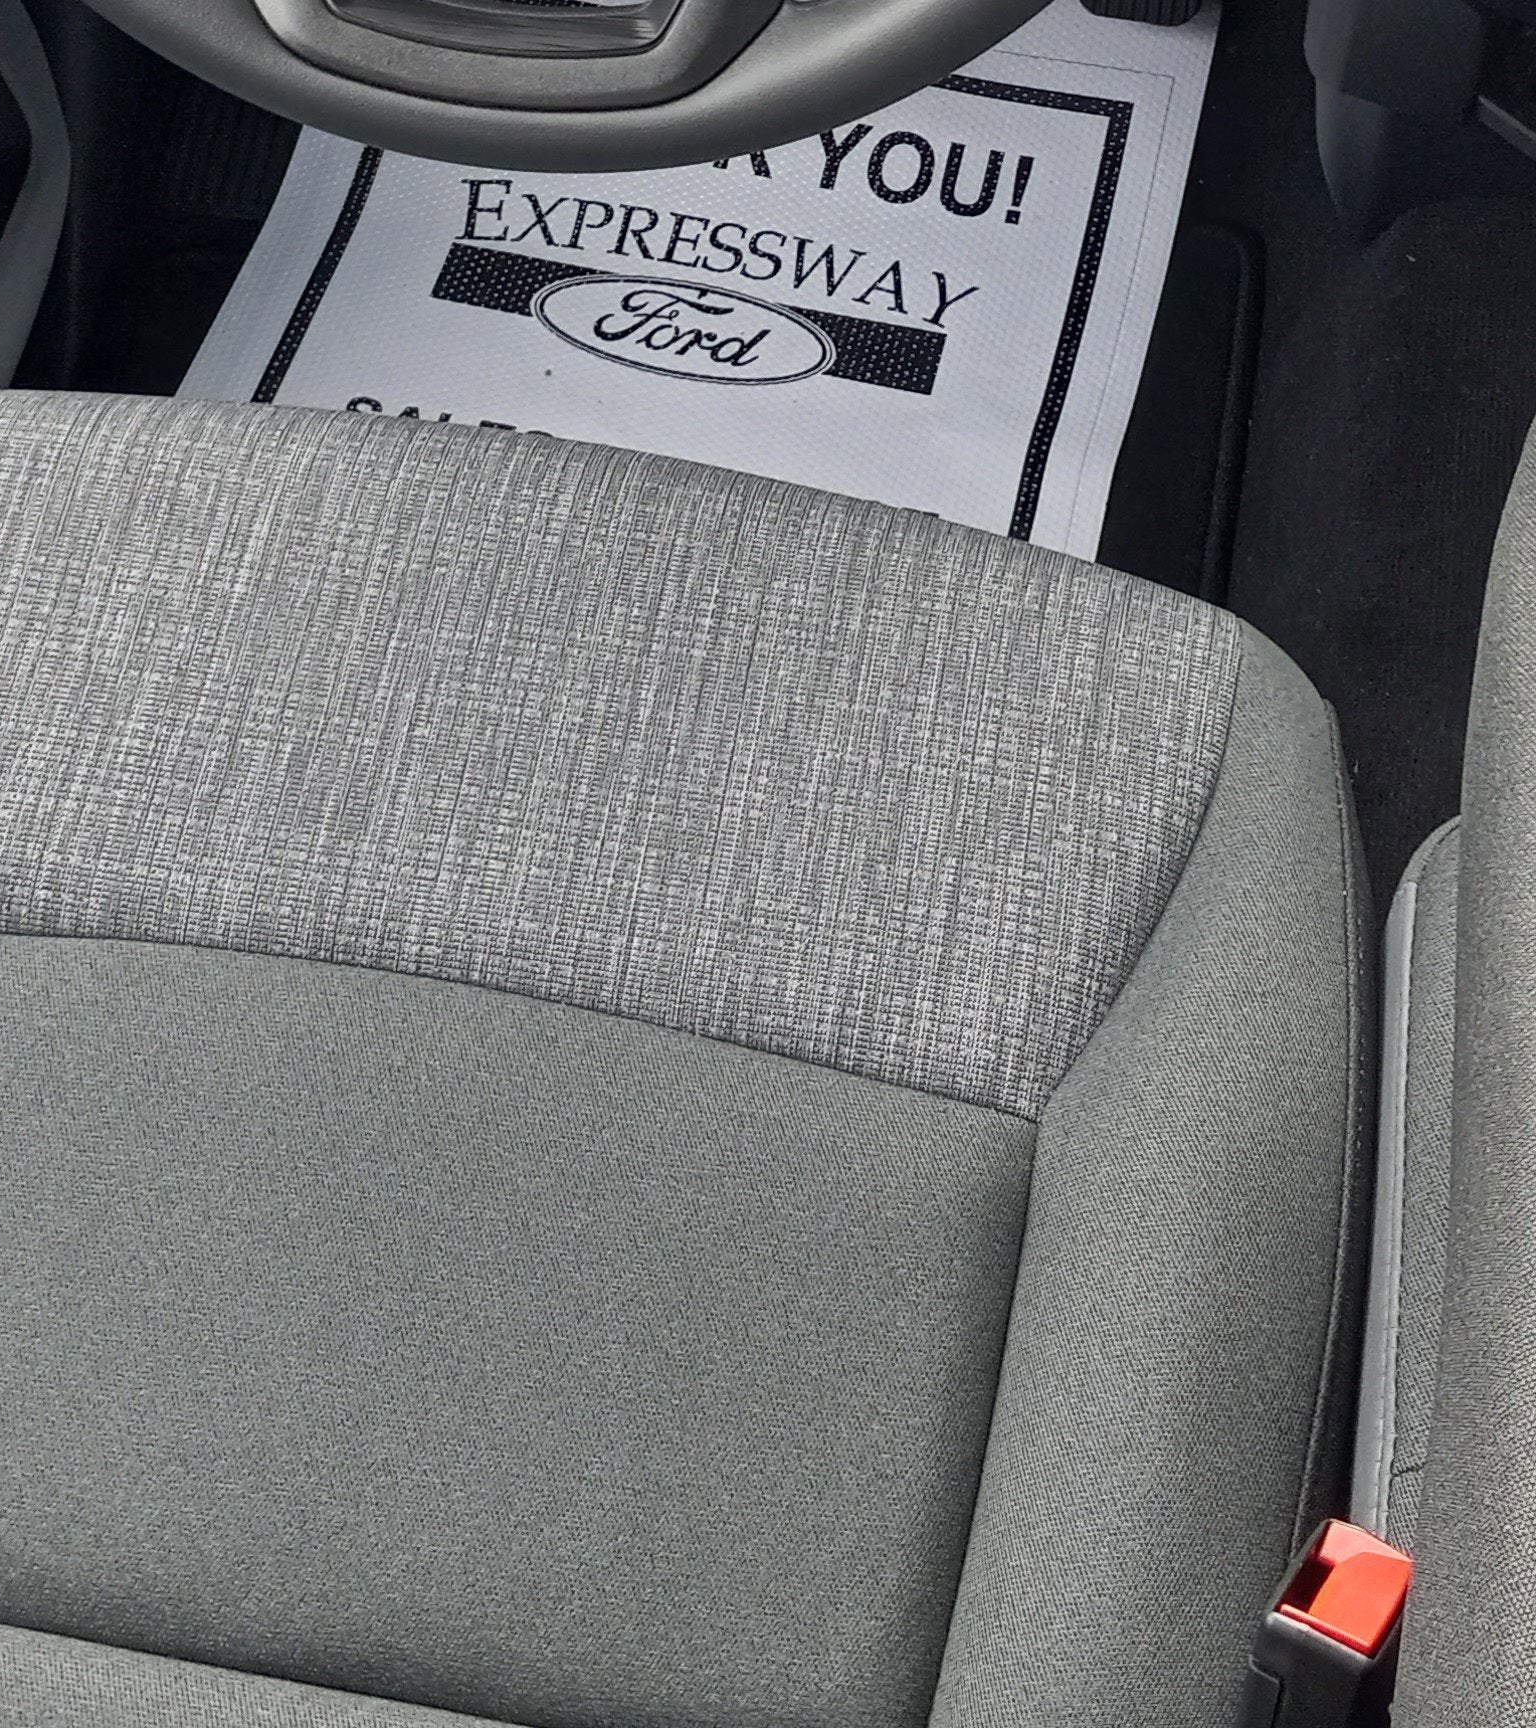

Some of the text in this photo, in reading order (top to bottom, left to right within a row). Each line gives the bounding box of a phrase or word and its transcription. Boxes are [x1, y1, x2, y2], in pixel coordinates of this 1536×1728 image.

[818, 123, 1035, 225] YOU!
[453, 177, 981, 330] EXPRESSWAY
[593, 287, 771, 369] Ford
